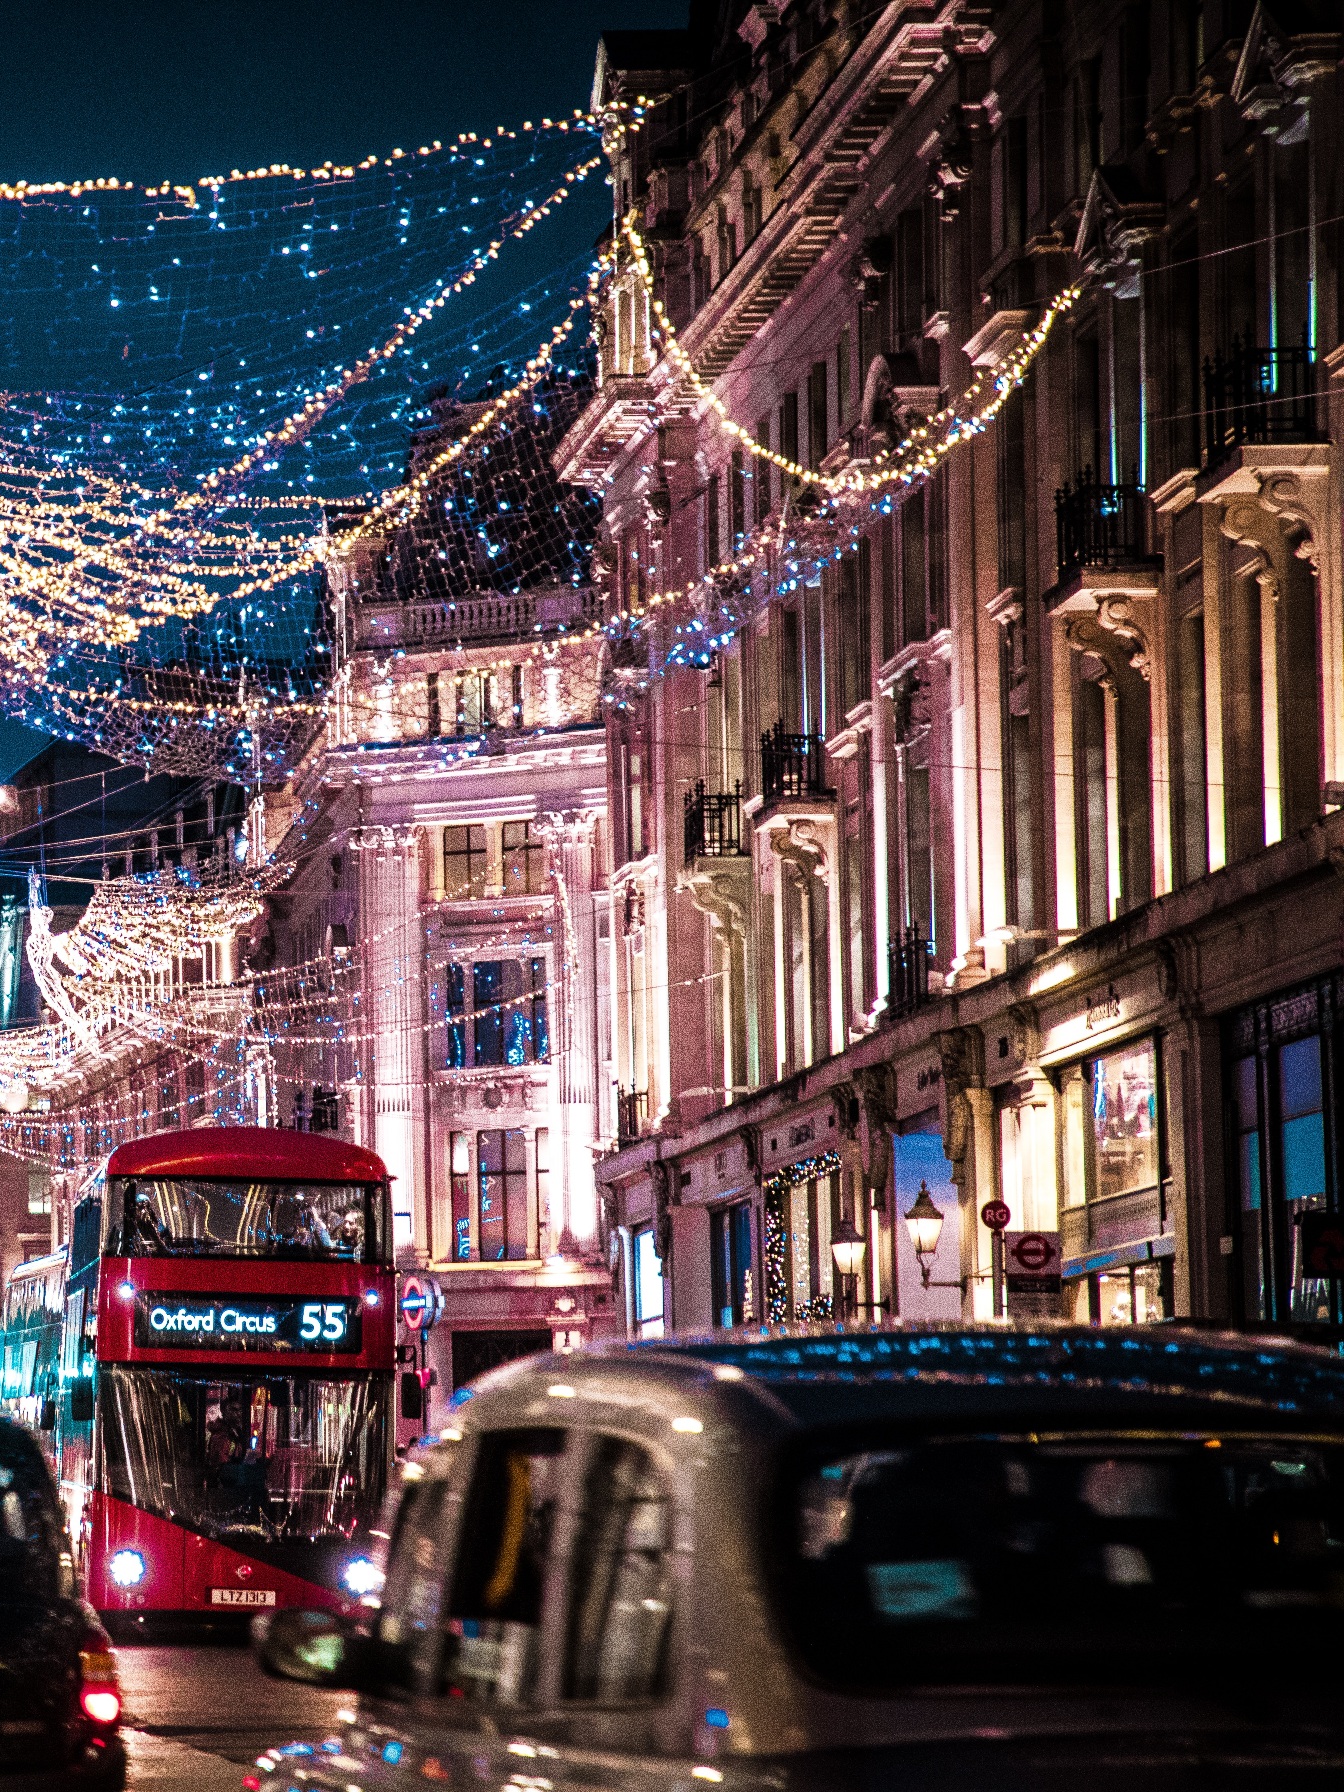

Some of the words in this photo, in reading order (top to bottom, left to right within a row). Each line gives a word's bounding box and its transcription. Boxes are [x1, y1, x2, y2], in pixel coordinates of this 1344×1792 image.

[985, 1209, 1007, 1222] RG
[150, 1307, 214, 1332] Oxford
[220, 1309, 276, 1333] Circus
[300, 1304, 345, 1340] 55
